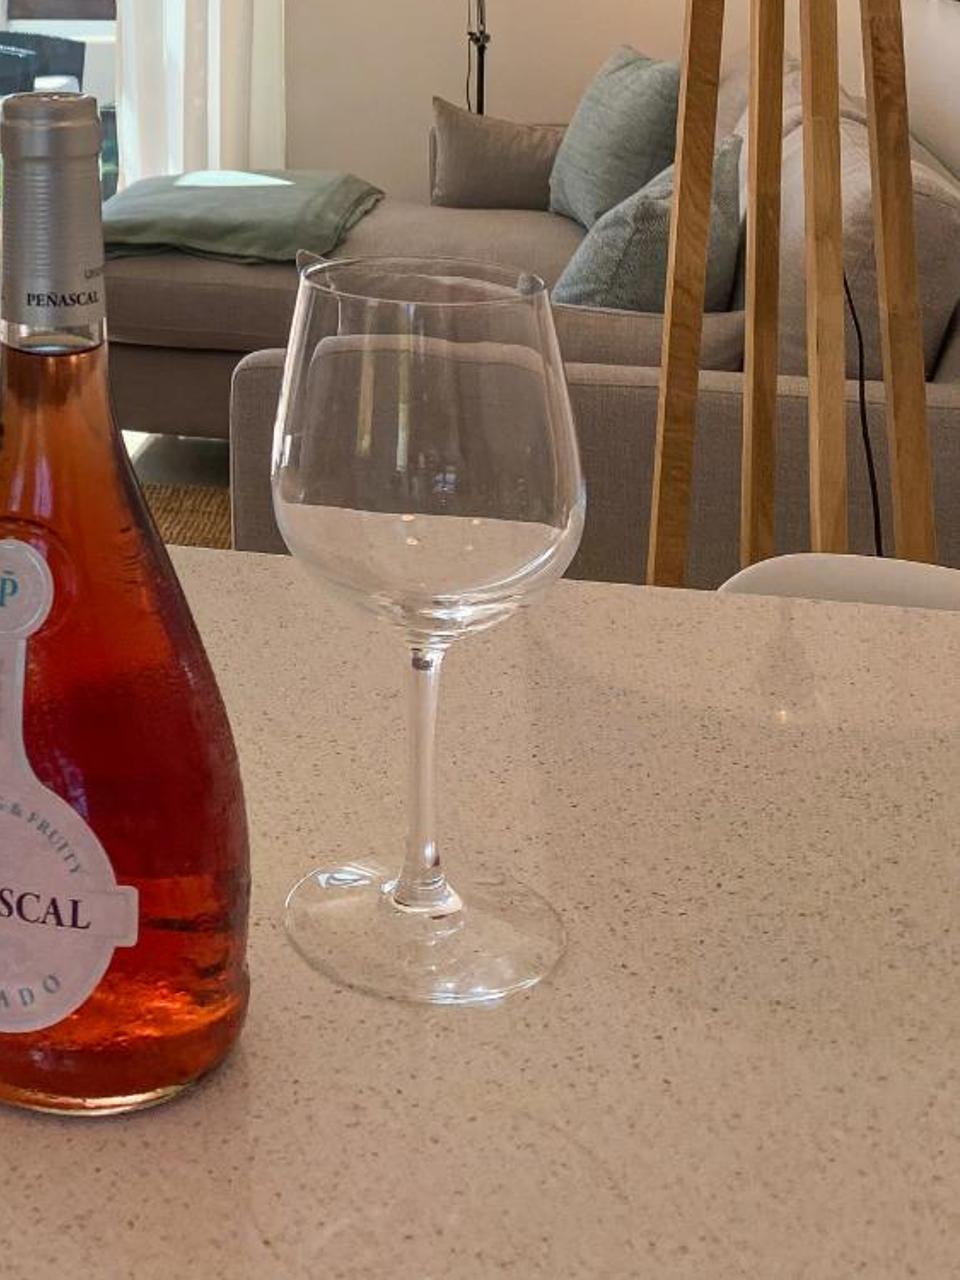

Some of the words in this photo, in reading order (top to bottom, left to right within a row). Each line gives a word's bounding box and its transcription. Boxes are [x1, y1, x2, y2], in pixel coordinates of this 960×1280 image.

[26, 291, 99, 307] PEÑASCAL
[8, 802, 23, 818] &
[26, 811, 82, 874] FRUITY
